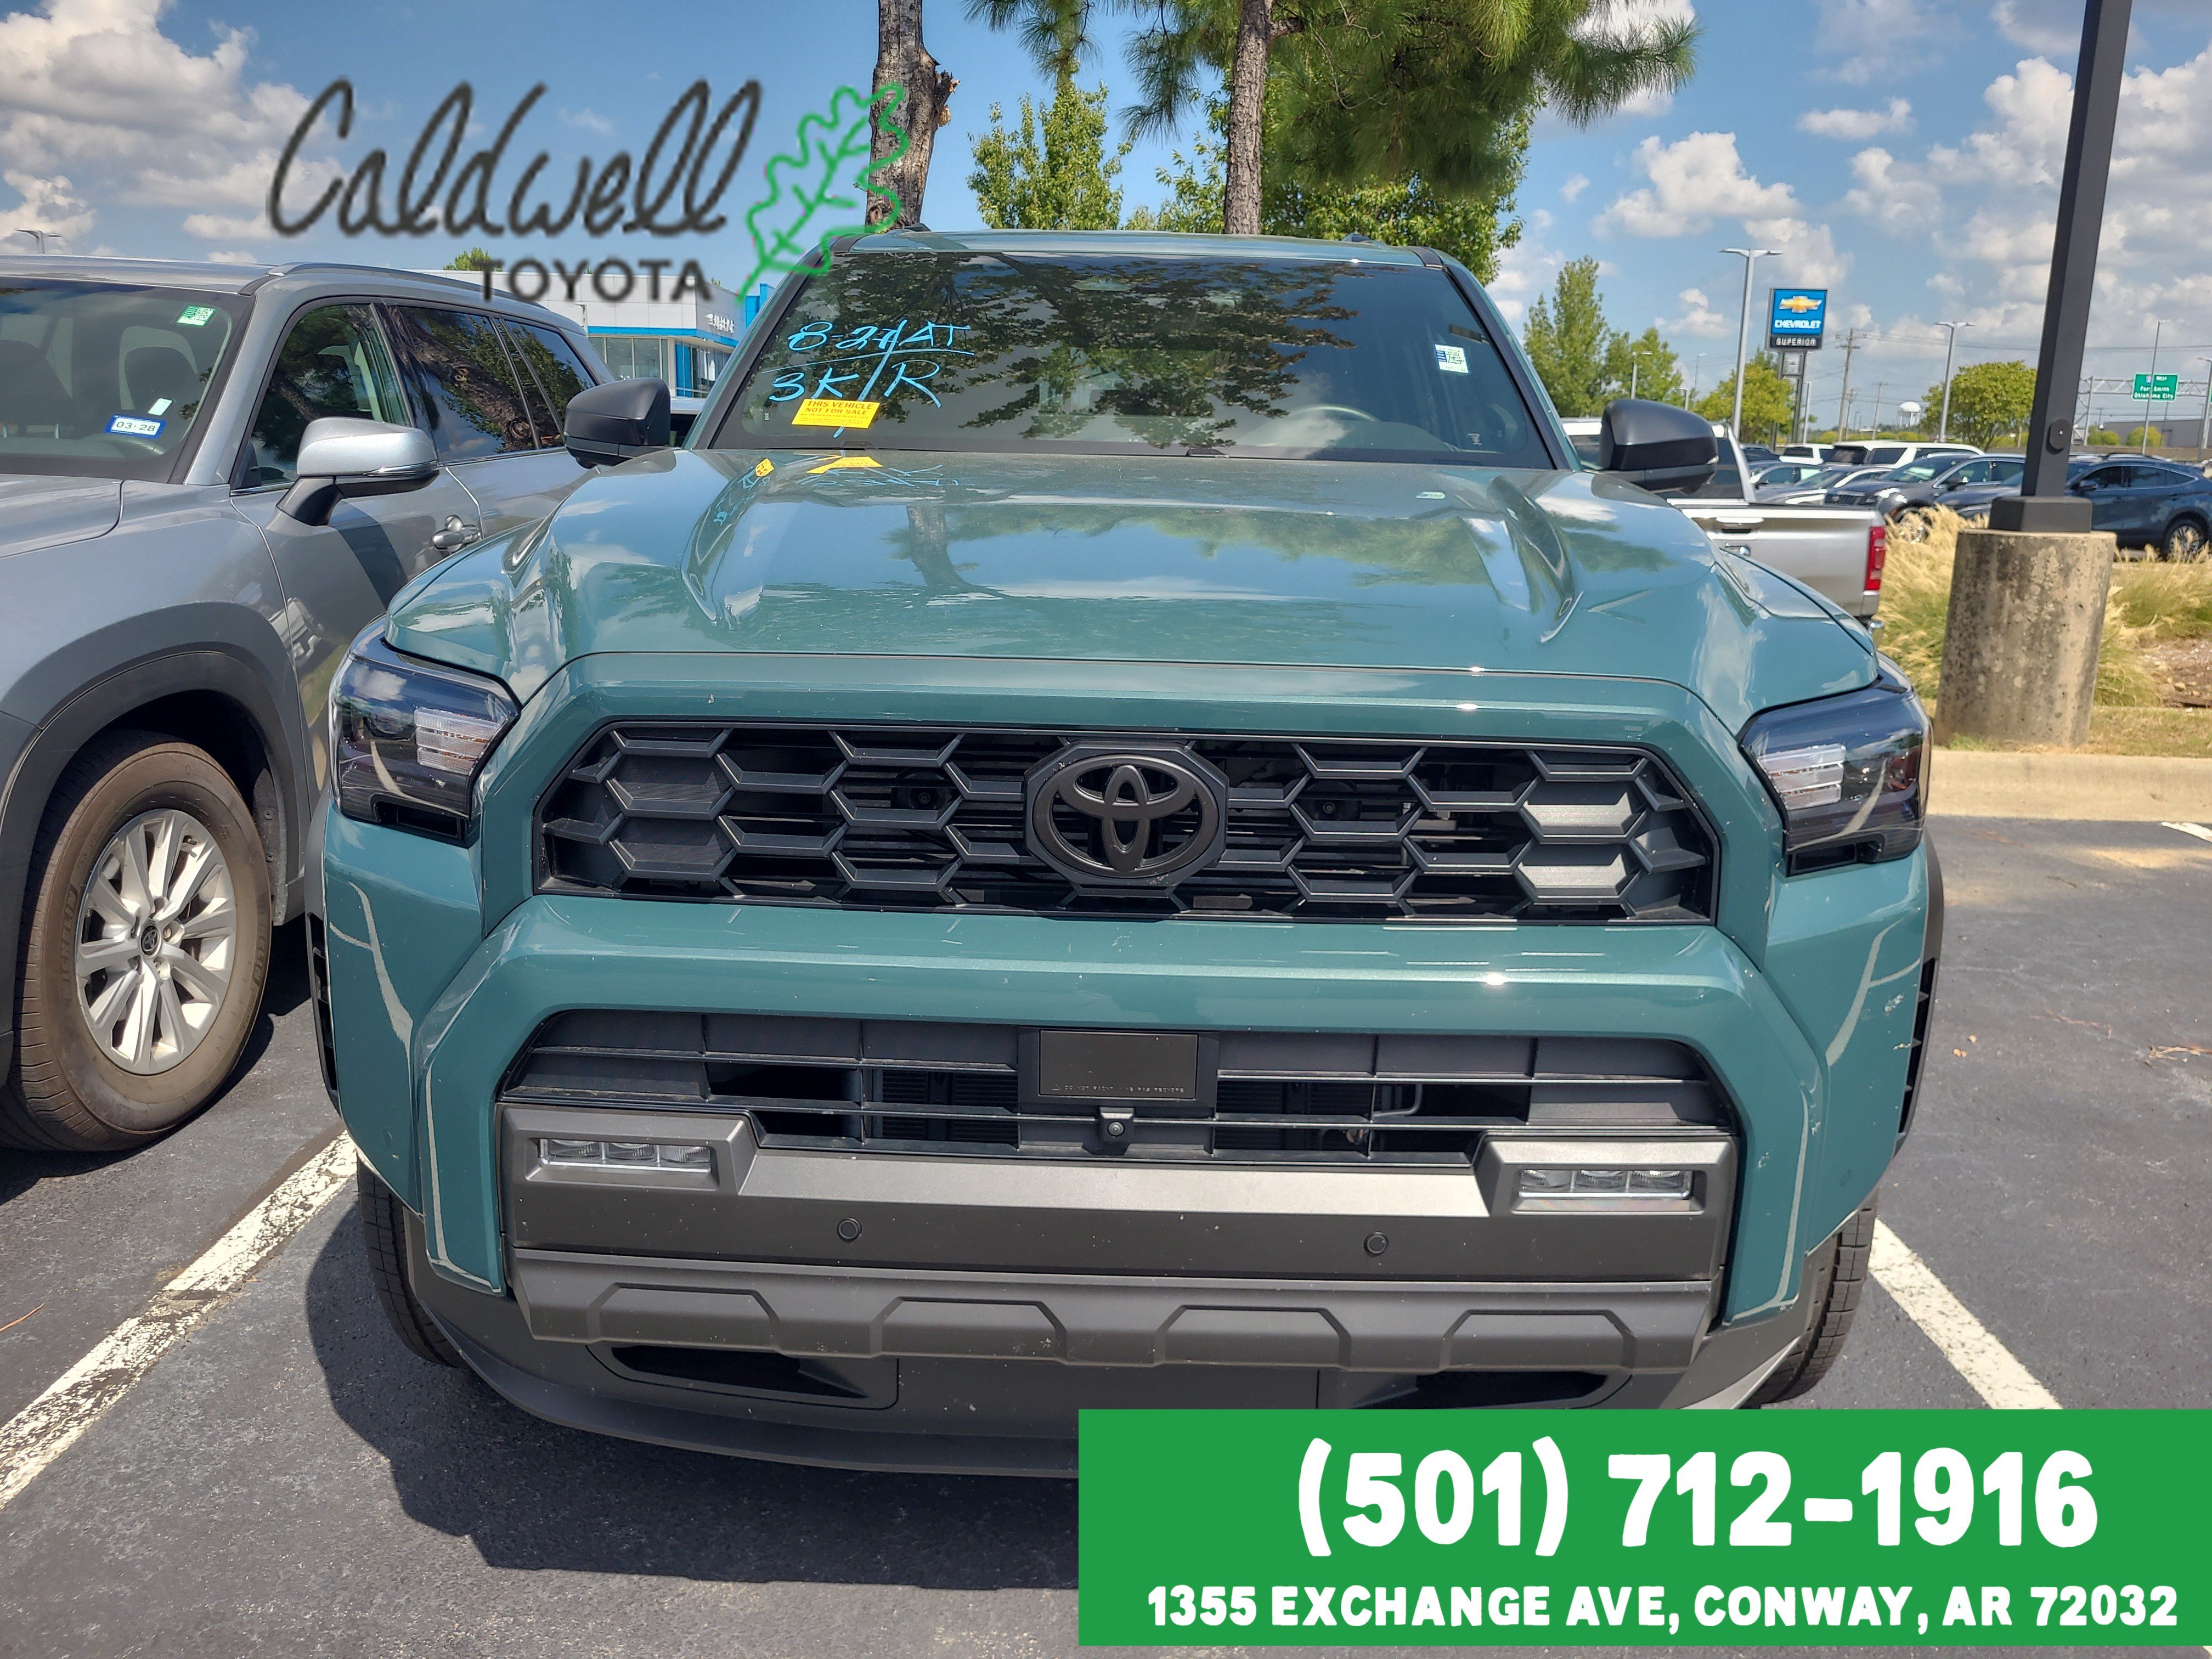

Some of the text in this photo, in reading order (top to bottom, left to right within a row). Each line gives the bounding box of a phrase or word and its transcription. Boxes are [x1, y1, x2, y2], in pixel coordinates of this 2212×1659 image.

[1774, 319, 1821, 329] CHEVROLET
[1776, 337, 1816, 346] SUPERIOR
[832, 402, 873, 410] VEHICLE
